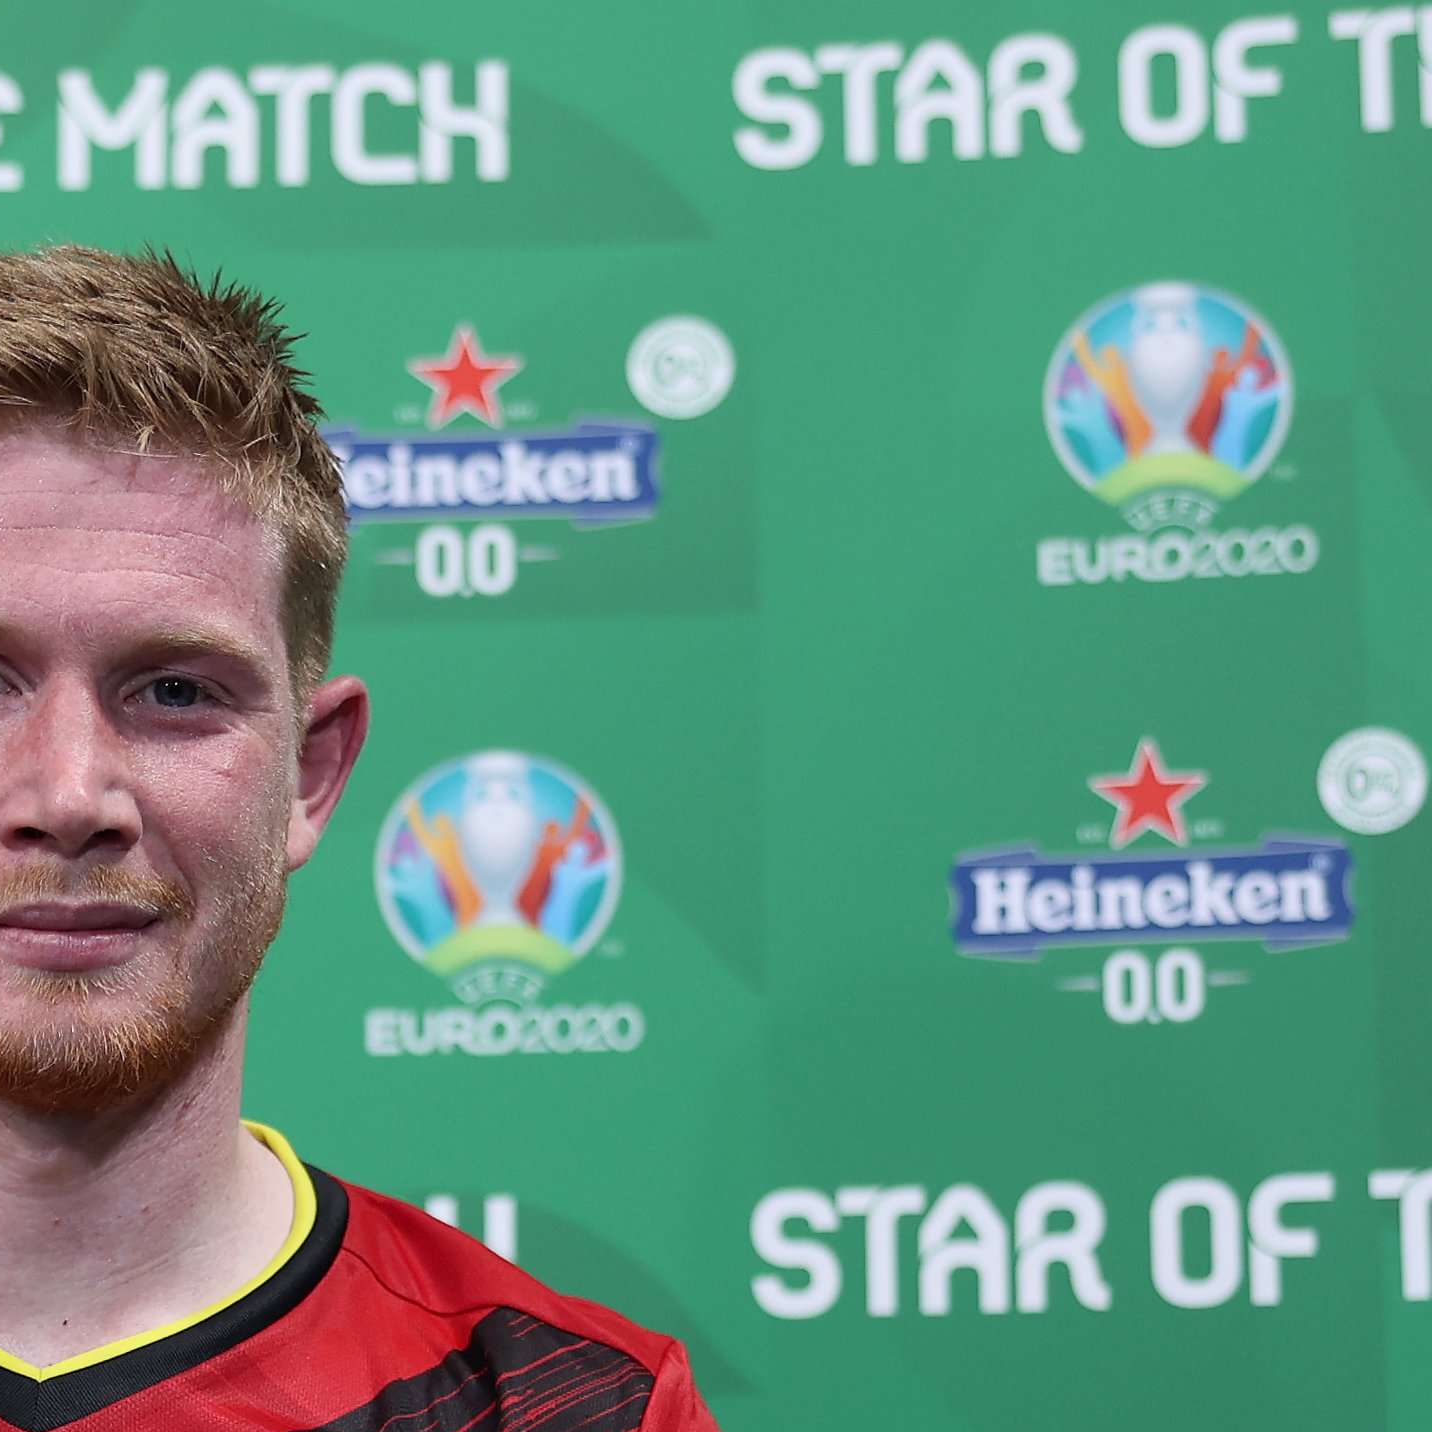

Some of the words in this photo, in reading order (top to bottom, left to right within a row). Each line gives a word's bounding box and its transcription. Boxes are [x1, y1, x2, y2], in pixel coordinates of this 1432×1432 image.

[57, 60, 509, 191] MATCH
[733, 34, 1083, 170] STAR
[1118, 16, 1298, 148] OF
[342, 442, 640, 507] eineken
[415, 523, 517, 597] 0.0
[1036, 526, 1319, 586] EURO2020
[972, 861, 1332, 935] Heineken
[1103, 949, 1205, 1024] 0.0
[364, 1003, 645, 1057] EURO2020
[751, 1182, 1111, 1320] STAR
[1150, 1175, 1335, 1309] OF
